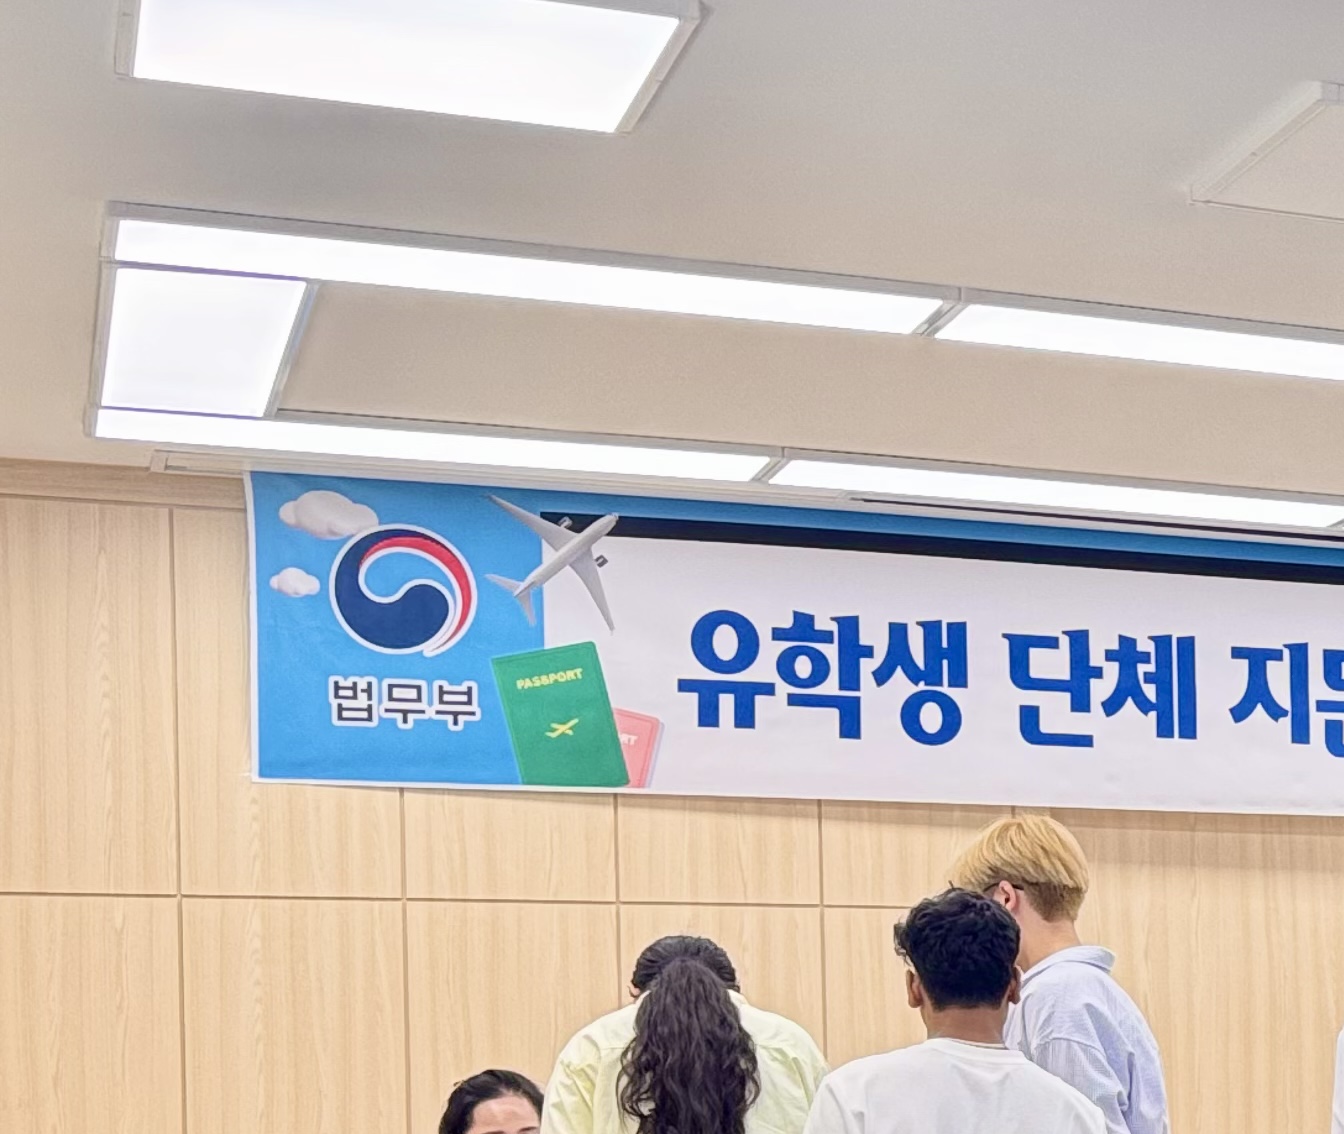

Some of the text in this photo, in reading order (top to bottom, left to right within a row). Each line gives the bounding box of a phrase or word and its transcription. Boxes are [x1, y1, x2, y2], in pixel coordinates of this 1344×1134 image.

[516, 667, 583, 690] PASSPORT
[676, 609, 970, 747] 유학생
[1002, 628, 1199, 749] 단체
[332, 680, 478, 728] 법무부
